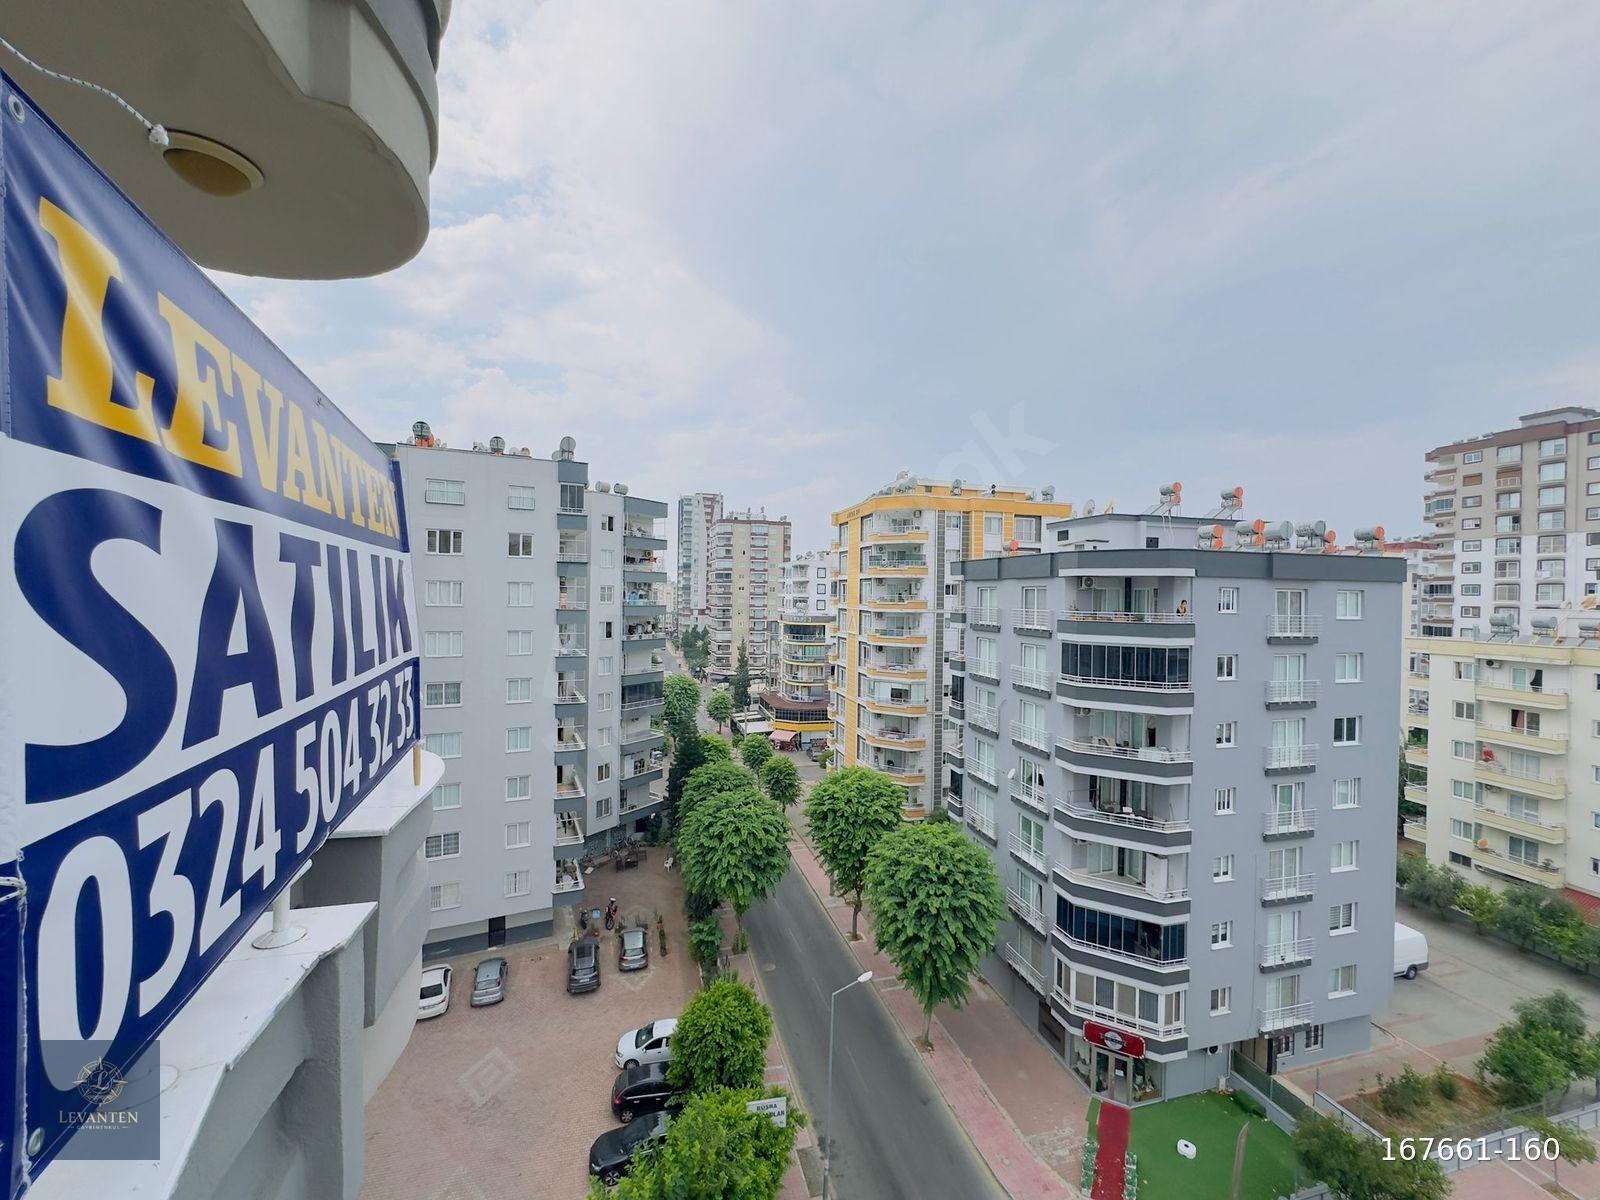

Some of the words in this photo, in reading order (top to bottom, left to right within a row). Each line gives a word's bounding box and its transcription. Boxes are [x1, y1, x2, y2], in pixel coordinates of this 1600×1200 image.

[38, 196, 400, 540] LEVANTEN
[14, 488, 413, 804] SATILIK
[37, 742, 283, 1092] 0324
[296, 695, 363, 854] 504
[368, 679, 393, 779] 32
[395, 666, 415, 750] 33
